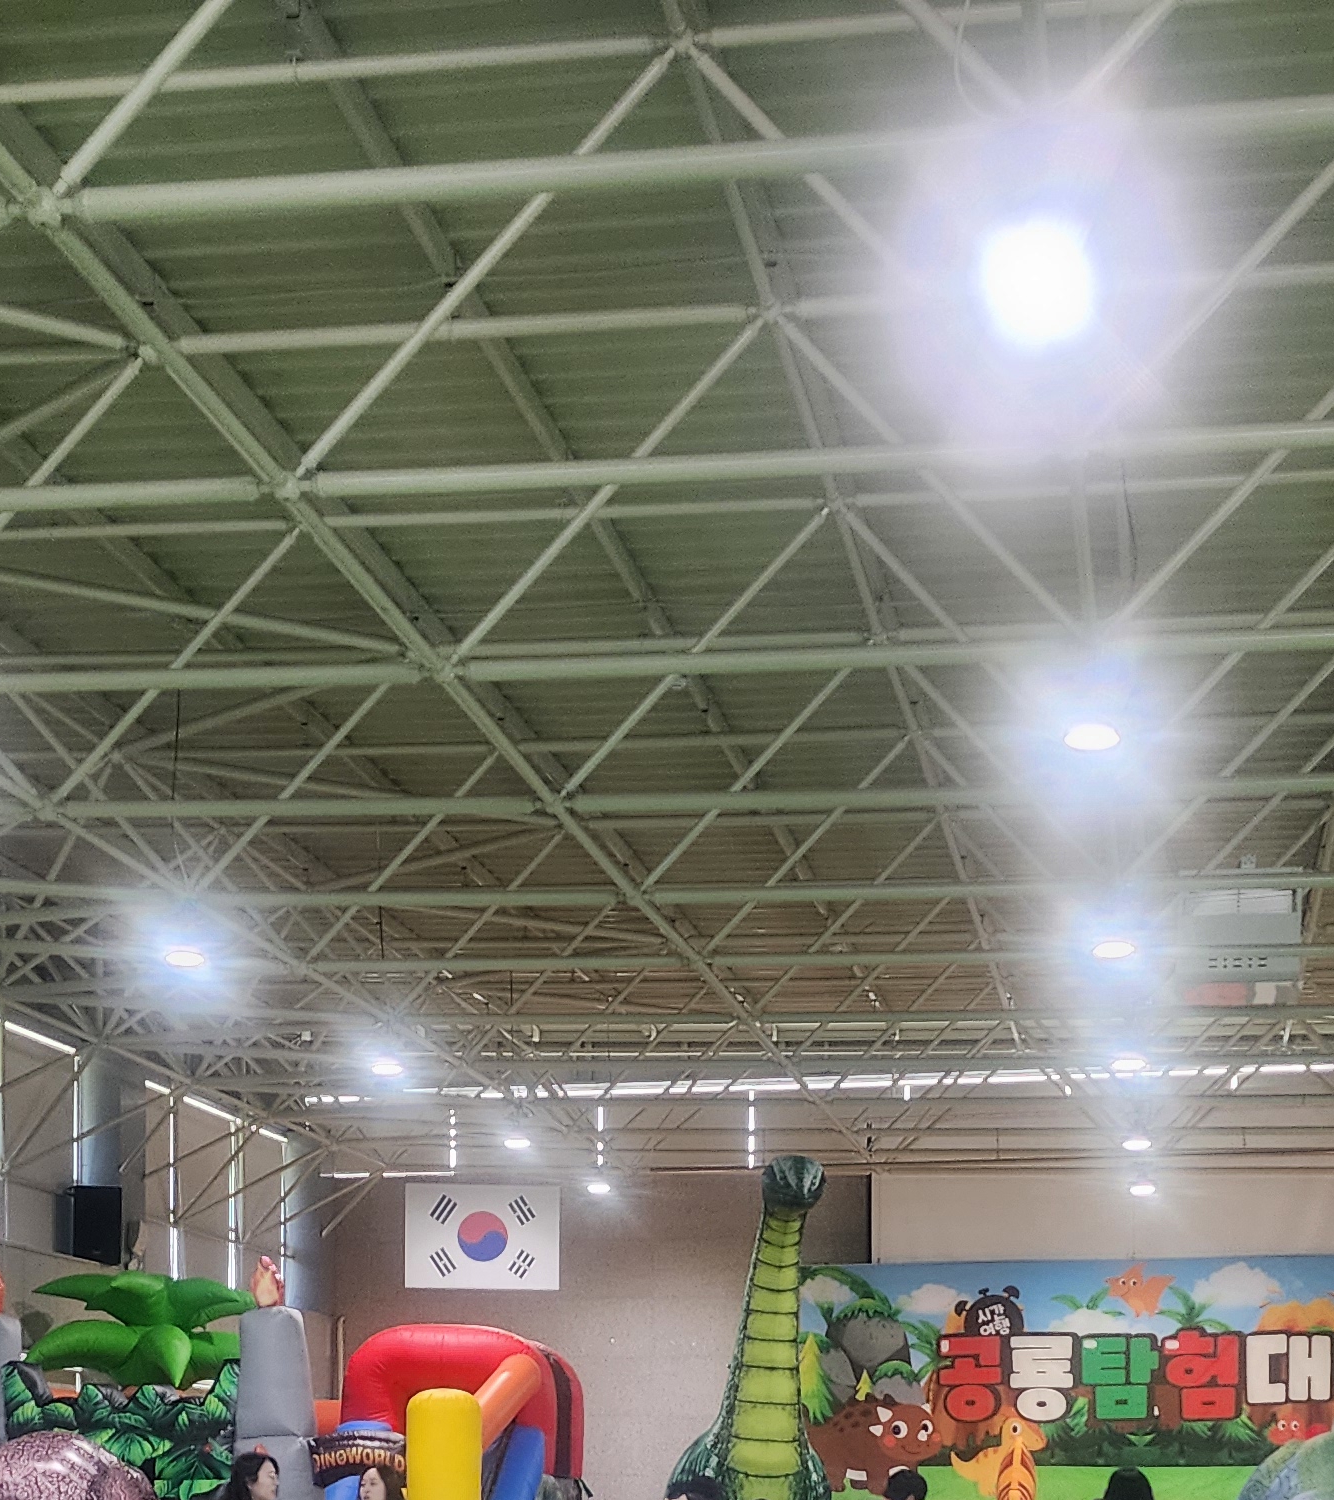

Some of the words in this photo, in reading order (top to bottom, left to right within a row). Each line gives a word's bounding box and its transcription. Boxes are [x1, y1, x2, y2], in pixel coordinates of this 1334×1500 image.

[977, 1304, 1005, 1323] 시간
[979, 1315, 1011, 1336] 여행
[938, 1329, 1334, 1422] 공룡탐험대
[312, 1446, 405, 1473] DINOWORLD
